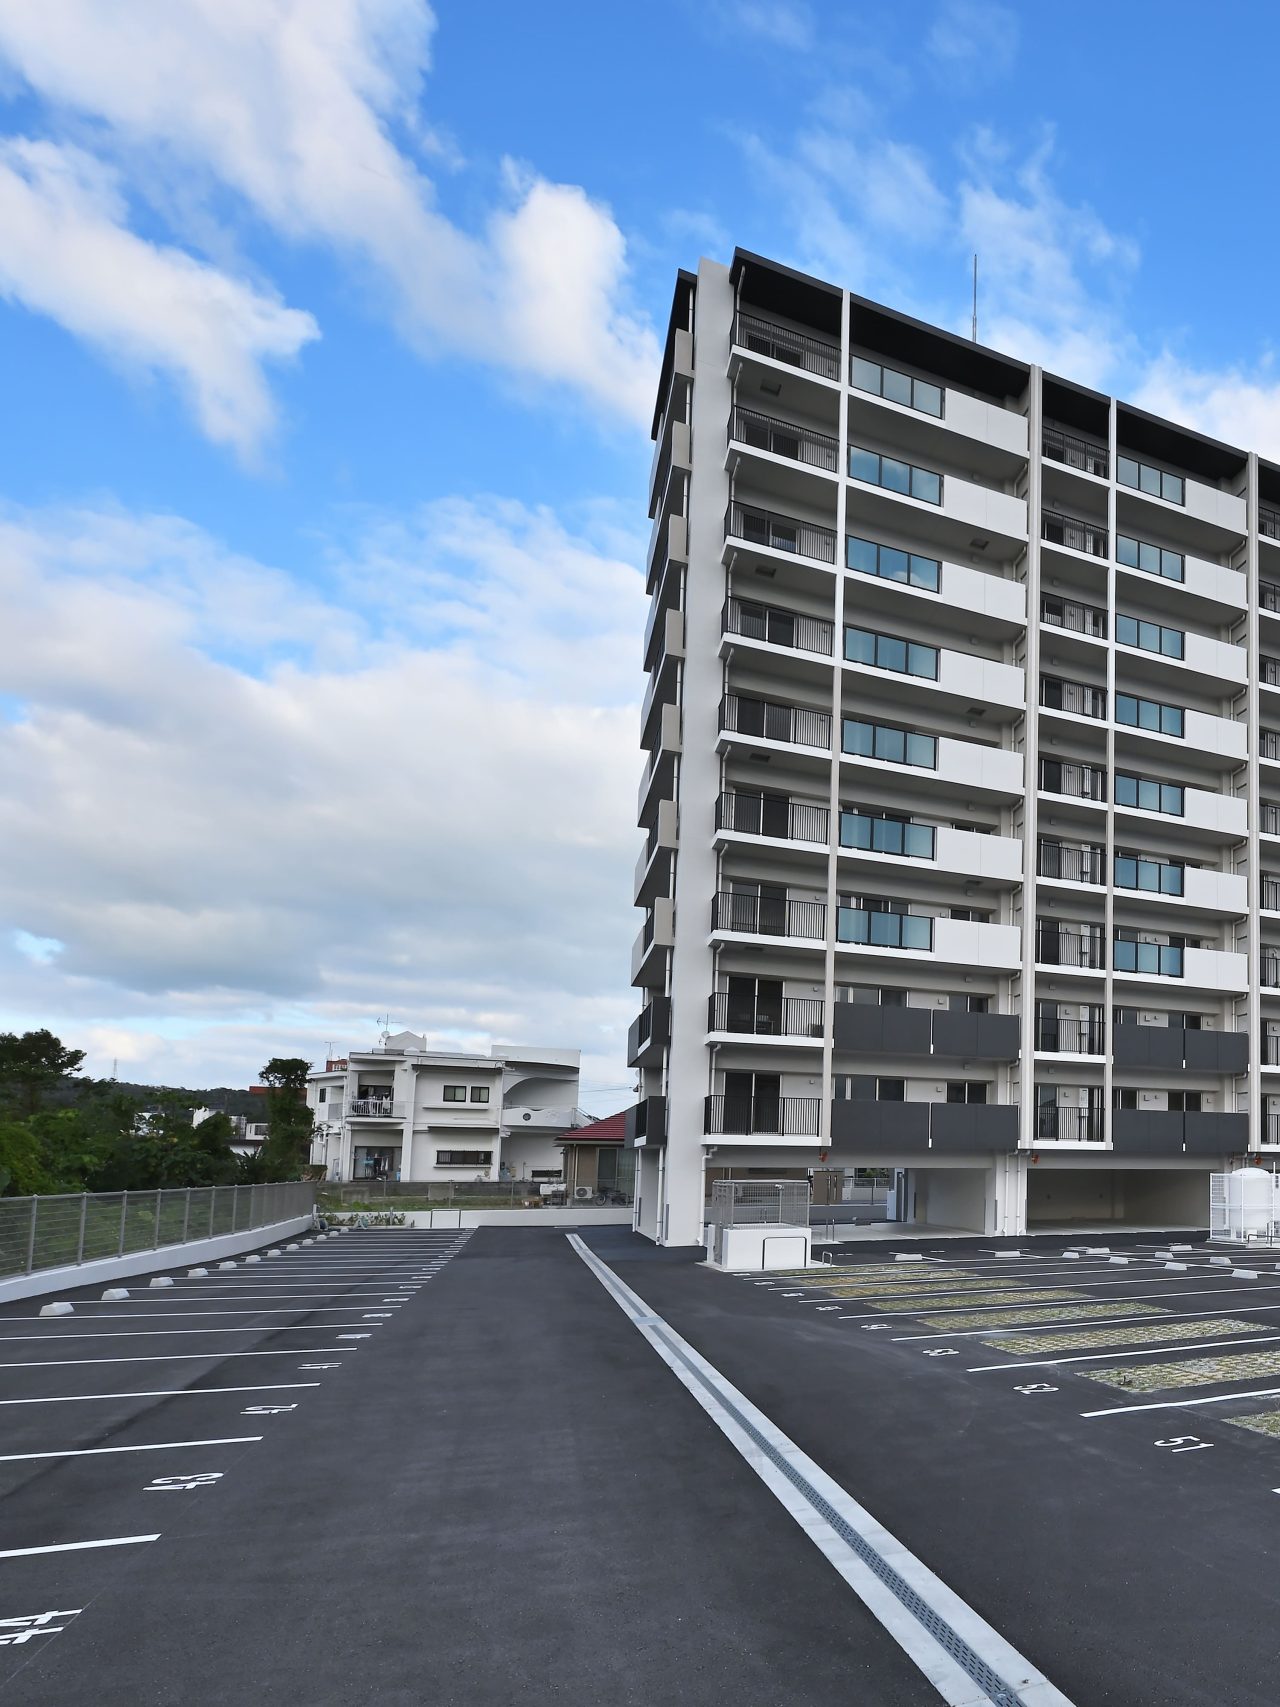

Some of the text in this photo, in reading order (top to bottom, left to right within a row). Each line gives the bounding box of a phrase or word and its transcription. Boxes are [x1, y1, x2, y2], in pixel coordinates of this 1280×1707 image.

[1013, 1383, 1059, 1395] 52
[240, 1403, 299, 1415] 42
[1153, 1435, 1214, 1453] 51
[142, 1472, 225, 1491] 43
